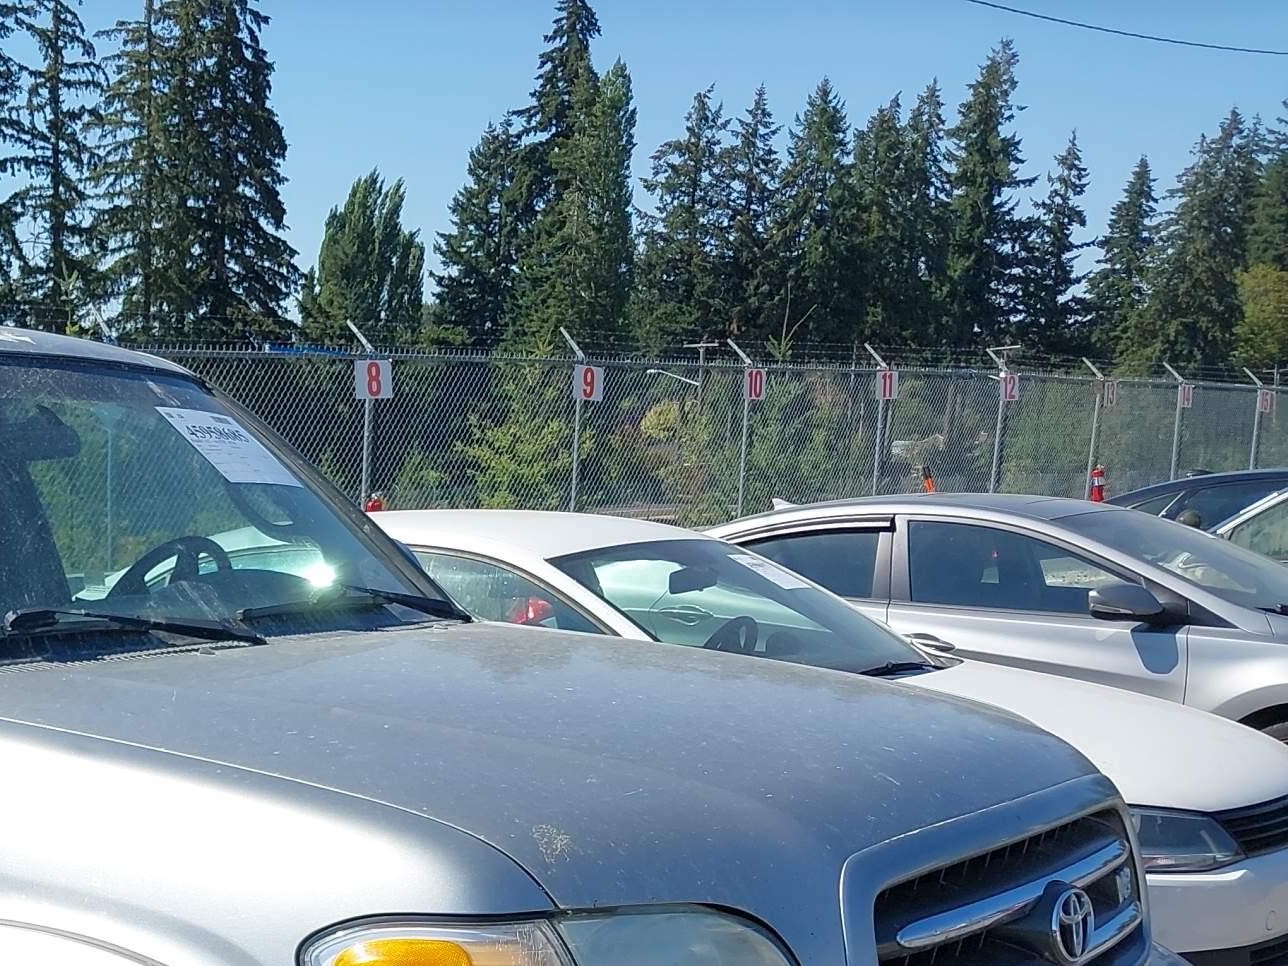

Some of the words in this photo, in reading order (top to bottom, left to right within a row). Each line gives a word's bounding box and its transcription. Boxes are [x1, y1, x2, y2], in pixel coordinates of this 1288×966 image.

[367, 362, 381, 396] 8
[583, 367, 595, 398] 9
[748, 370, 763, 397] 10
[881, 372, 893, 398] 11
[1003, 375, 1016, 399] 12
